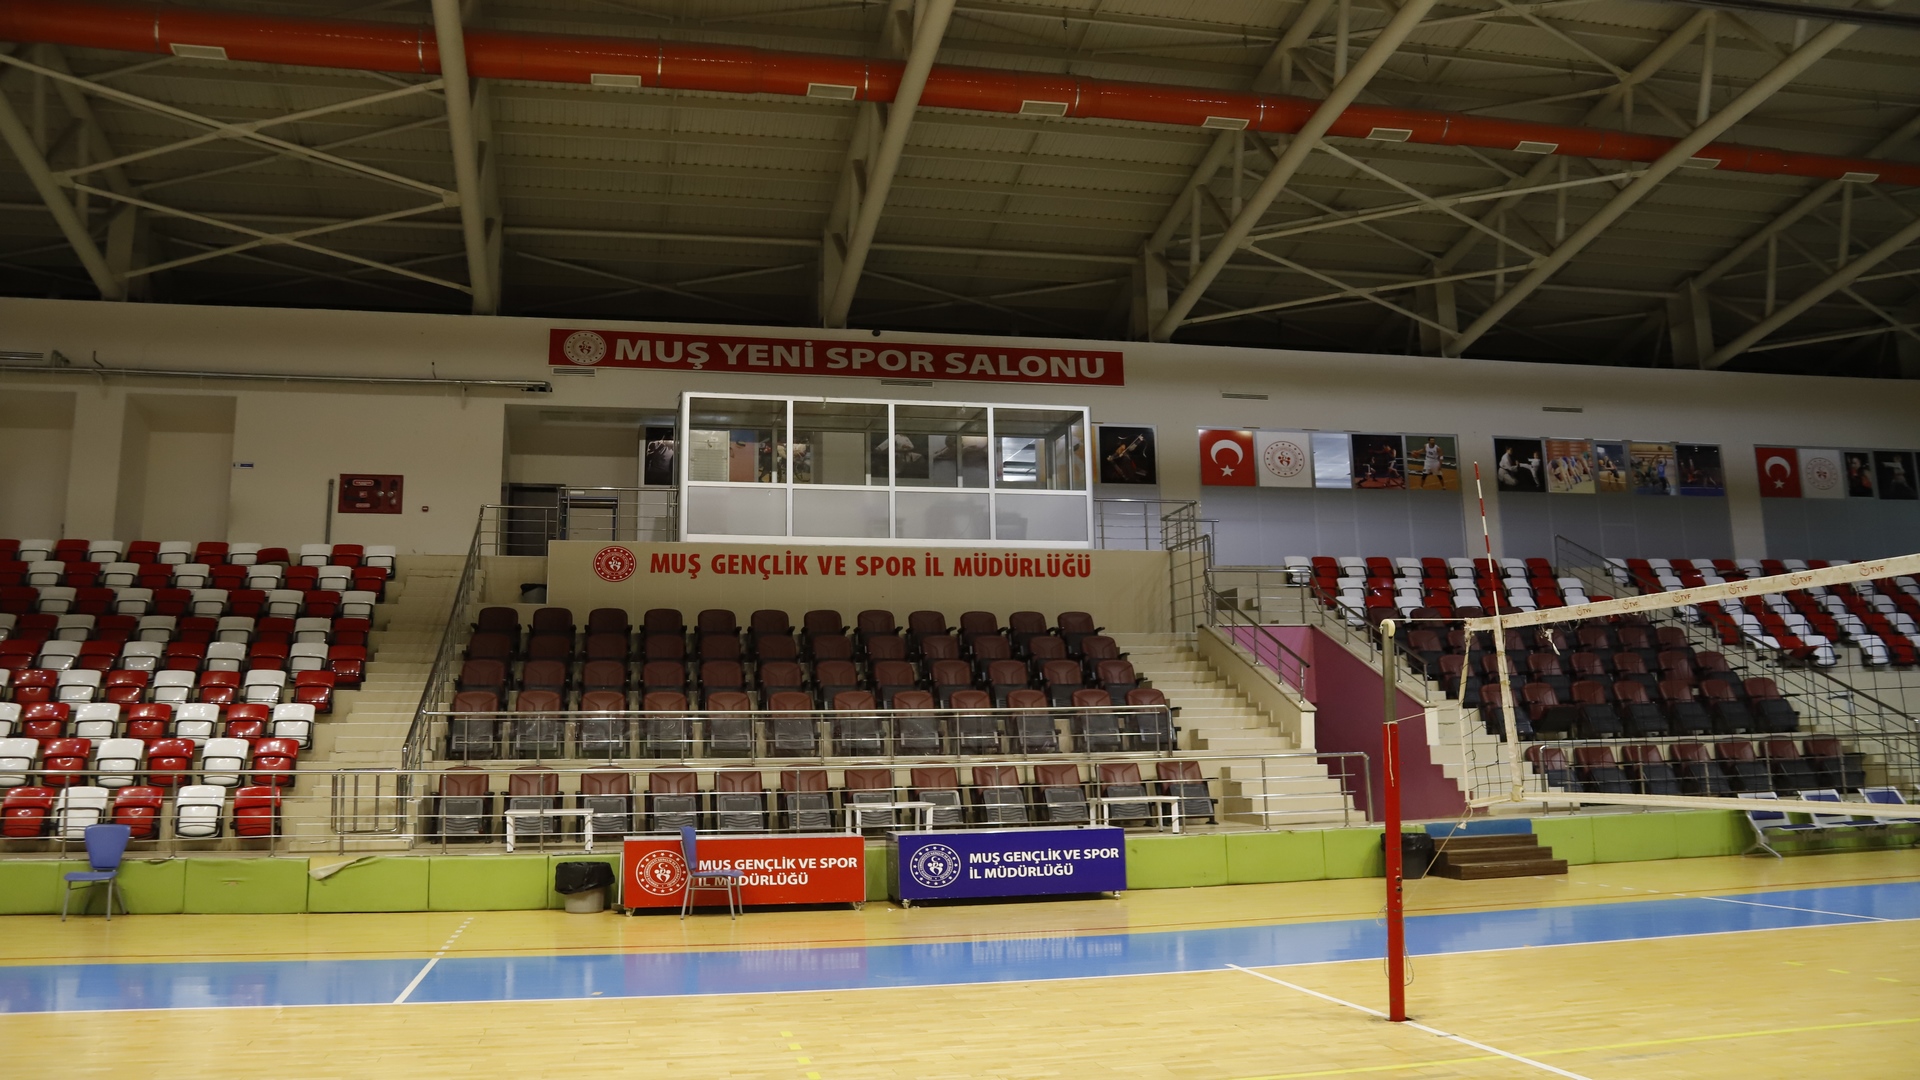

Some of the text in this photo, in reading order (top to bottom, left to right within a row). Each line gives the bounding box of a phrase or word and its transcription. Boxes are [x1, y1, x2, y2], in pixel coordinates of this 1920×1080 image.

[615, 338, 709, 369] MUŞ
[719, 341, 814, 368] YENİ
[826, 347, 935, 372] SPOR
[945, 353, 1105, 378] SALONU
[650, 553, 701, 579] MUŞ
[711, 550, 808, 580] GENÇLİK
[817, 555, 846, 576] VE
[855, 556, 916, 576] SPOR
[925, 552, 944, 577] İL
[953, 552, 1091, 578] MÜDÜRLÜĞÜ
[1870, 565, 1885, 574] TVF
[1799, 575, 1813, 584] TVF
[1736, 585, 1749, 593] TVF
[734, 856, 796, 872] GENÇLİK
[798, 859, 816, 869] VE
[820, 857, 857, 868] SPOR
[969, 848, 1119, 865] MUŞ GENÇLİK VE SPOR
[969, 866, 982, 879] İL
[984, 863, 1074, 879] MÜDÜRLÜĞÜ
